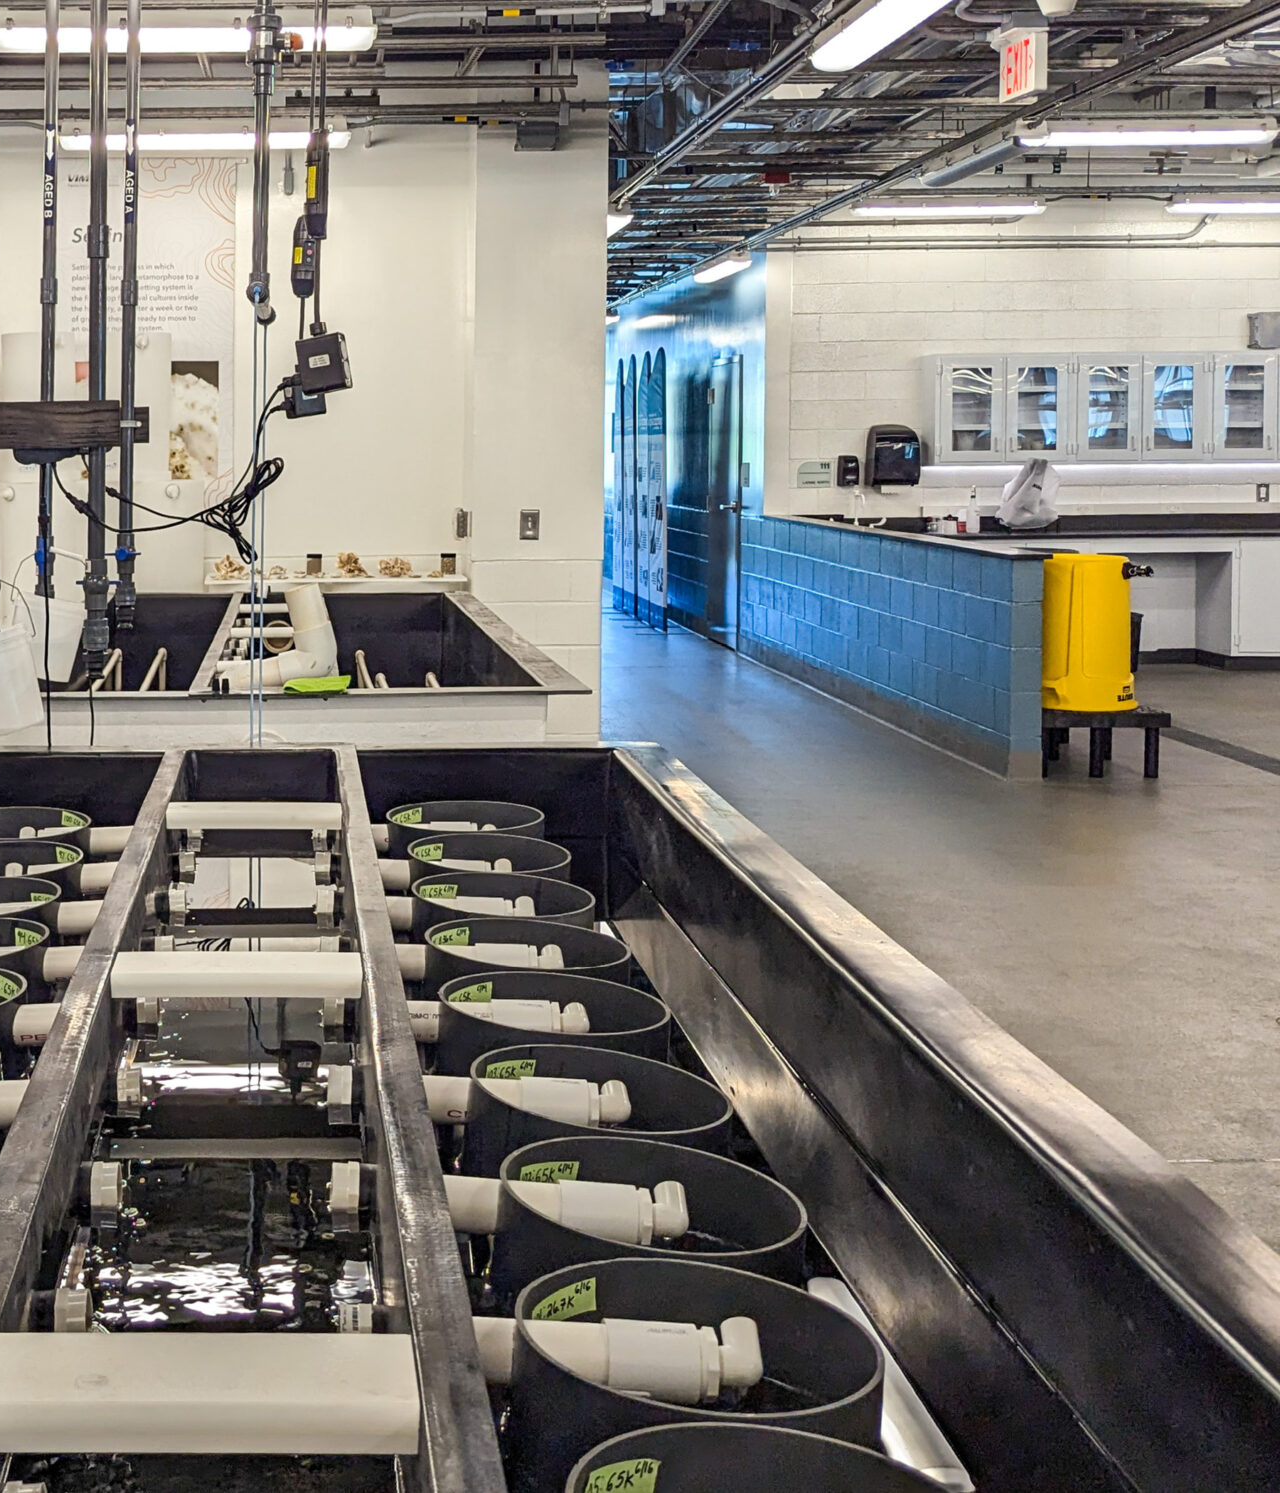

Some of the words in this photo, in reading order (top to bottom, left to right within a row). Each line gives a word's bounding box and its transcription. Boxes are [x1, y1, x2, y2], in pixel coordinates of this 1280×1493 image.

[1006, 39, 1029, 96] EXIT
[44, 174, 53, 207] AGED
[125, 170, 134, 202] AGED
[44, 210, 53, 218] B
[125, 205, 133, 213] A
[634, 1460, 654, 1478] 6/16
